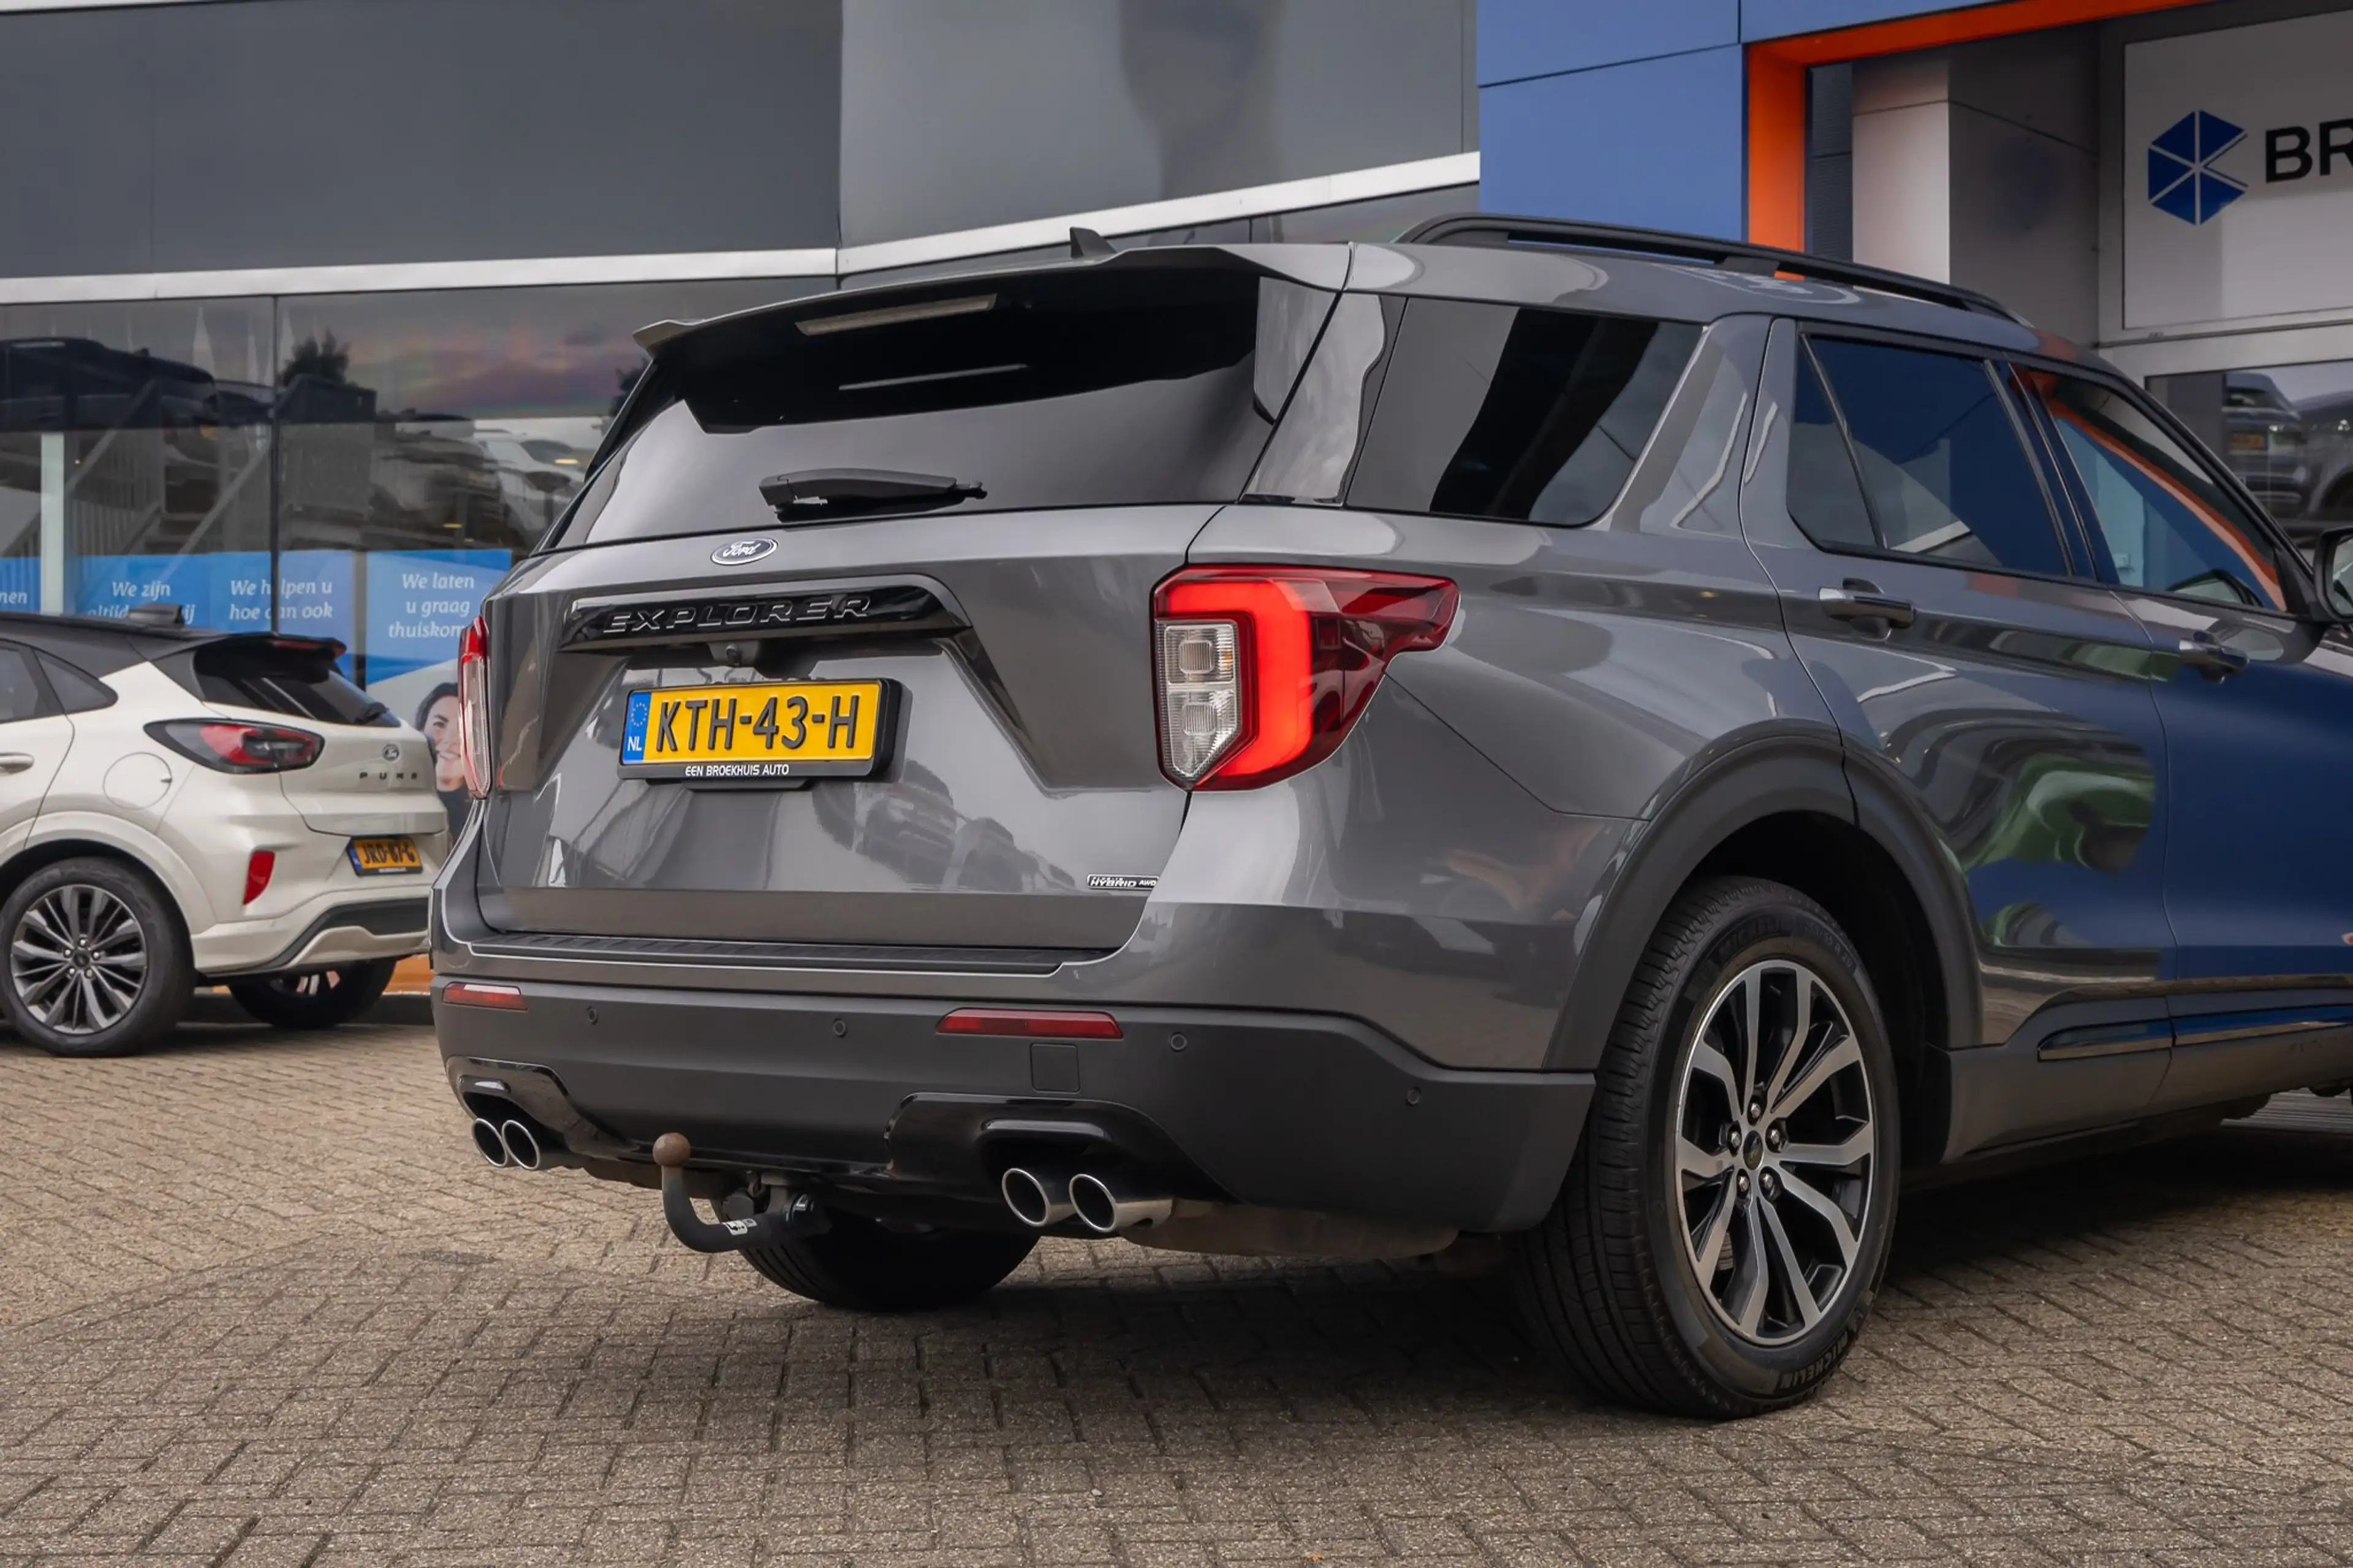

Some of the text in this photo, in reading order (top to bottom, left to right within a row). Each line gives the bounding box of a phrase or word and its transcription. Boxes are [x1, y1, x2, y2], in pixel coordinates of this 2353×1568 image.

[2265, 118, 2353, 183] BR
[722, 540, 761, 557] Ford
[230, 578, 332, 599] We hlpen u
[402, 571, 475, 589] We laten
[112, 581, 171, 601] We zijn
[229, 604, 260, 620] hoe
[302, 602, 333, 619] ook
[406, 600, 471, 618] u graag
[603, 595, 872, 634] EXPLORER
[656, 694, 860, 752] KTH-43-H
[627, 737, 642, 752] NL
[685, 763, 789, 777] EEN BROEKHUIS AUTO
[1090, 878, 1137, 887] HYBRID
